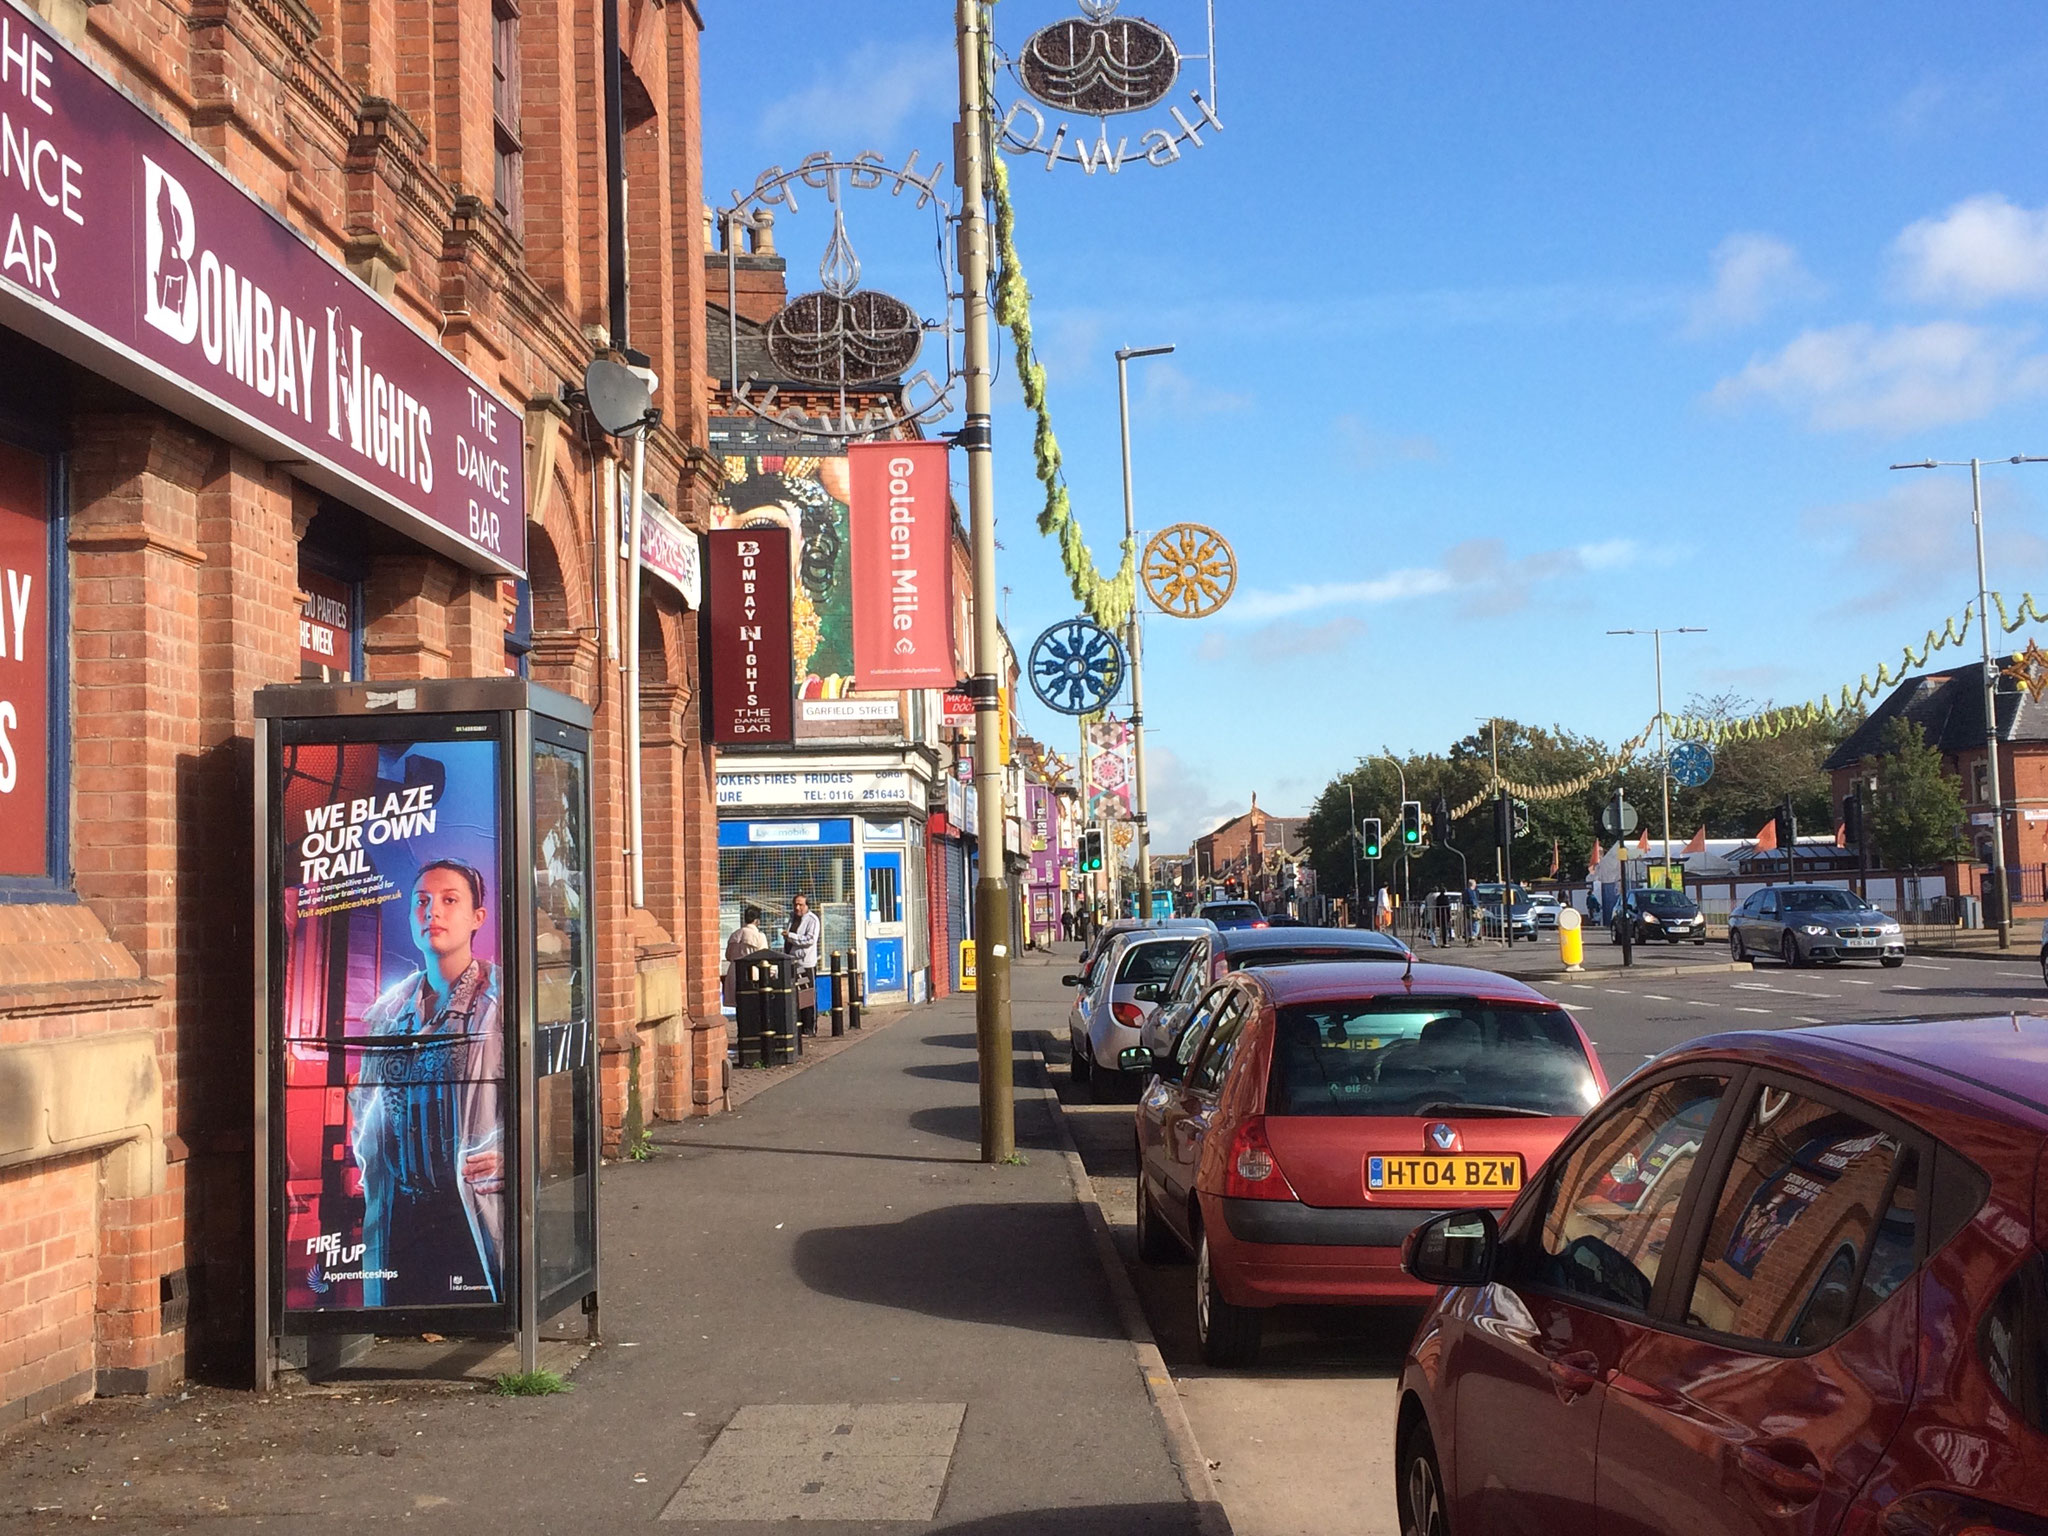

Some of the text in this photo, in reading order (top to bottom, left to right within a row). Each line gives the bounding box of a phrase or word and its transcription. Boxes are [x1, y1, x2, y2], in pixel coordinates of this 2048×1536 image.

[2, 17, 53, 116] HE
[995, 89, 1223, 174] Diwali
[1, 112, 84, 226] NCE
[3, 212, 60, 299] AR
[142, 154, 434, 494] BOMBAY NIGHTS
[467, 386, 498, 444] THE
[456, 435, 510, 505] DANCE
[469, 498, 501, 552] BAR
[888, 457, 919, 631] Golden Mile
[317, 594, 347, 630] PARTIES
[737, 541, 762, 706] BOMBAY NIGHTS
[300, 620, 334, 657] HE WEEK
[734, 708, 771, 717] THE
[806, 705, 895, 716] GARFIELD STREET
[734, 724, 772, 734] BAR
[716, 789, 905, 803] URE TEL: 0116 2516443
[764, 773, 797, 785] FIRES
[805, 772, 853, 784] FRIDGES
[304, 784, 434, 833] WE BLAZE
[302, 809, 437, 858] OUR OWN
[300, 849, 371, 884] TRAIL
[298, 880, 395, 906] and get your training paid for
[299, 886, 316, 897] Earn
[321, 878, 363, 893] competitive
[363, 874, 384, 885] salary
[297, 890, 402, 919] Visit apprenticeships.gov.uk
[1387, 1161, 1516, 1186] HT04 BZW
[306, 1232, 342, 1255] FIRE
[325, 1243, 367, 1268] IT UP
[323, 1269, 399, 1281] Apprenticeships
